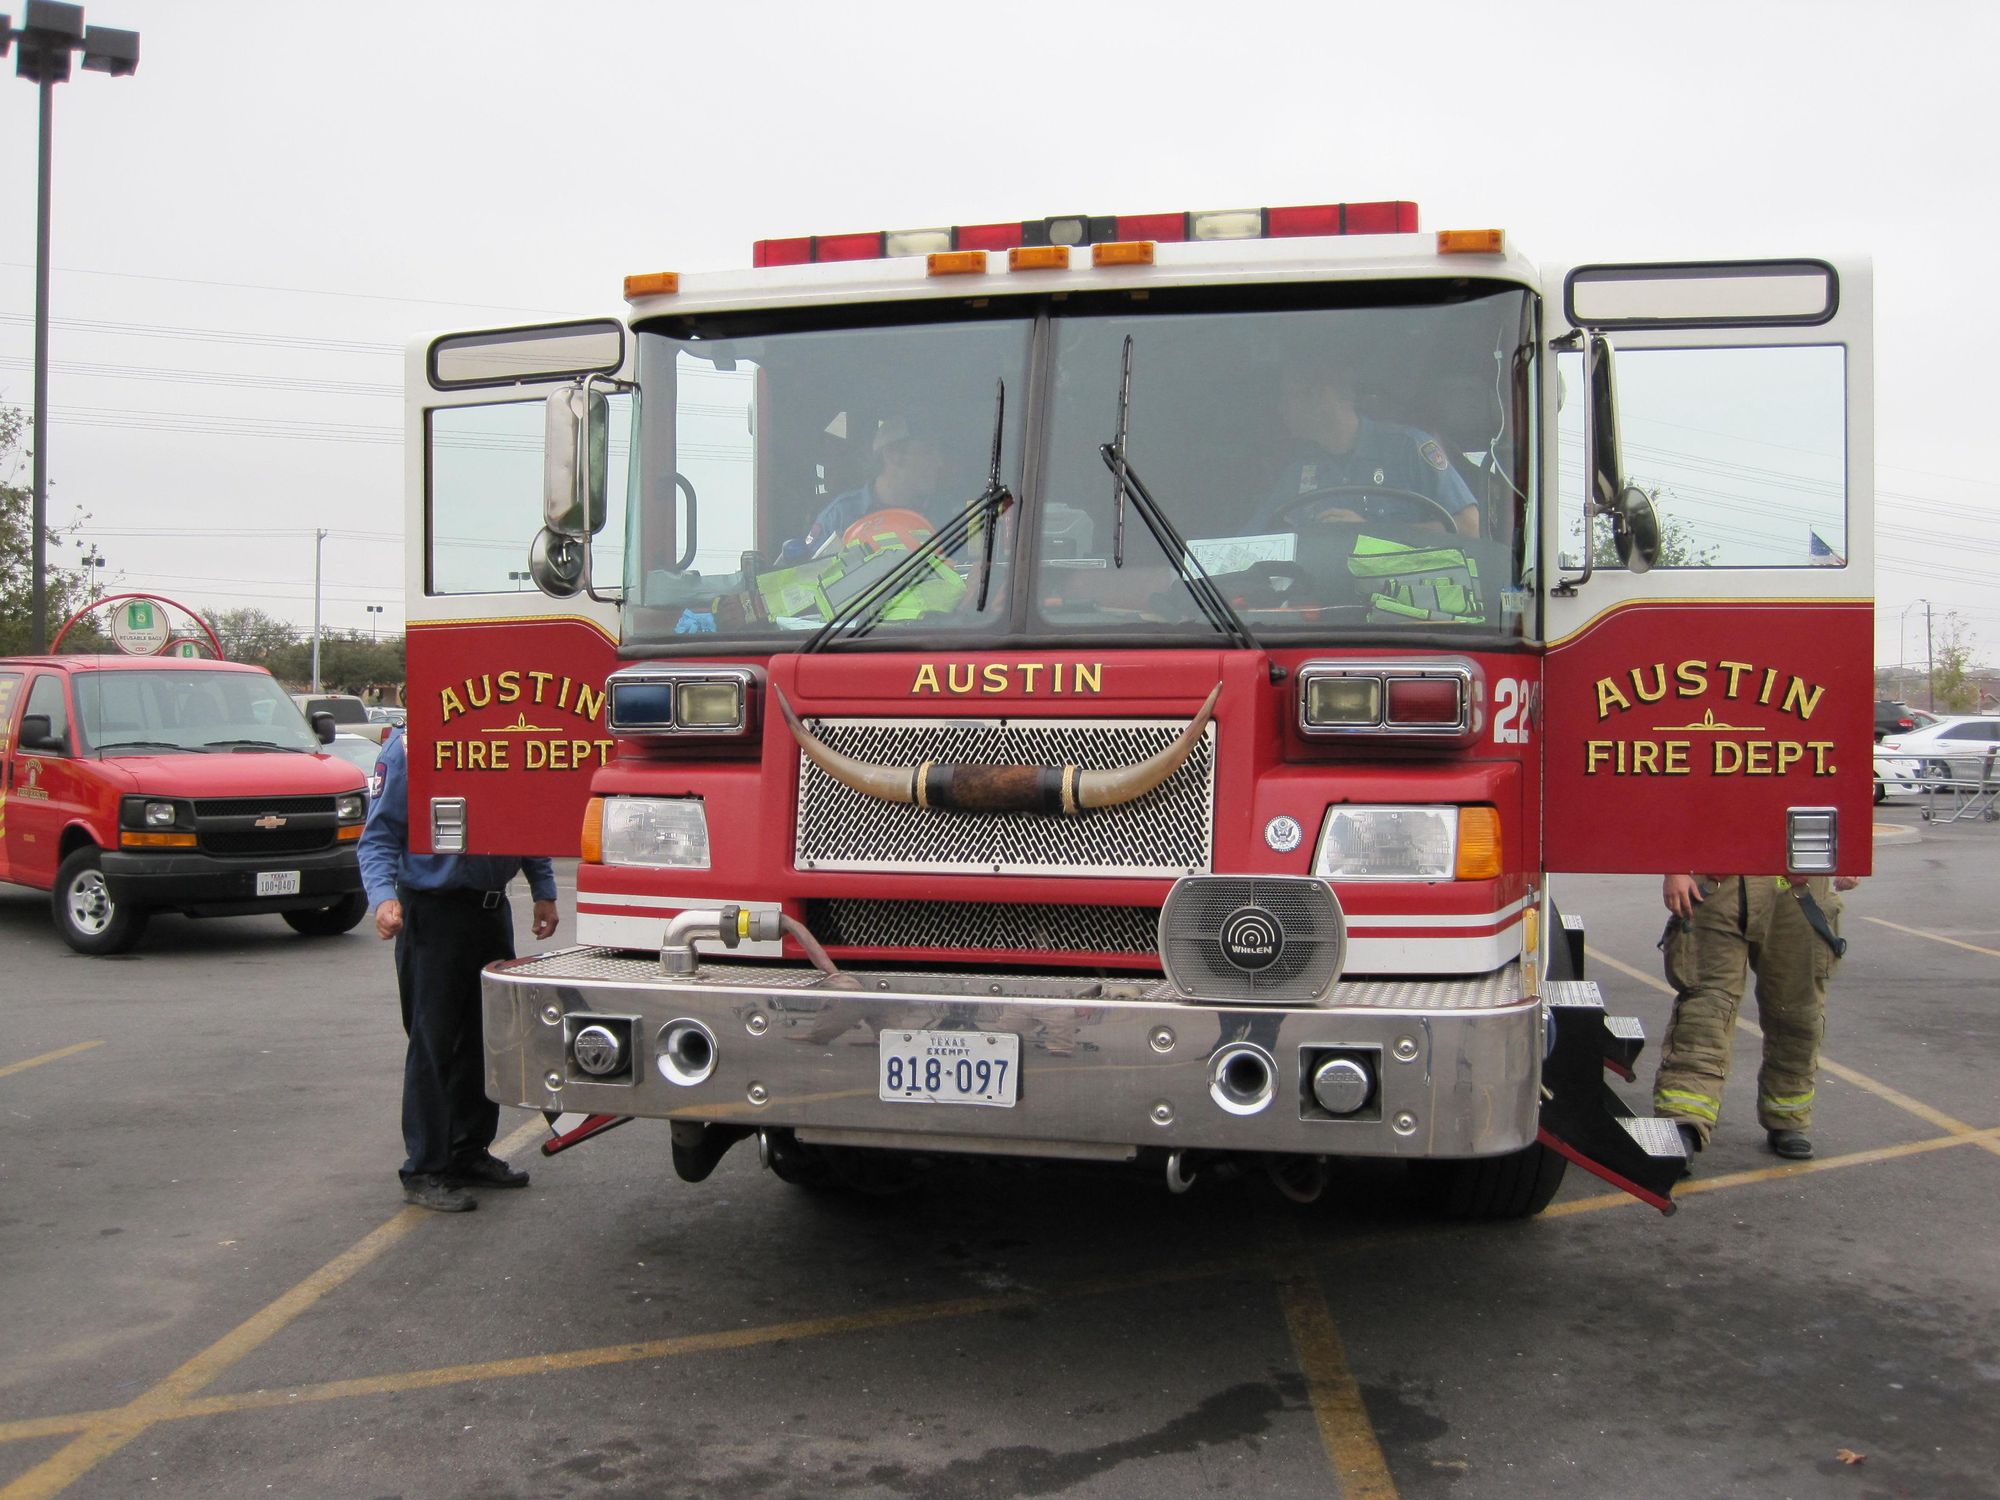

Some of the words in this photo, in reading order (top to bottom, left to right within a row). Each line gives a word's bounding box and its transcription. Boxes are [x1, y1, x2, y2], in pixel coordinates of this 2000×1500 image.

[911, 663, 1102, 693] AUSTIN
[1596, 660, 1826, 720] AUSTIN
[439, 671, 605, 722] AUSTIN
[1493, 677, 1529, 743] 22
[435, 741, 510, 770] FIRE
[526, 740, 614, 769] DEPT
[1585, 740, 1691, 774] FIRE
[1713, 740, 1838, 774] DEPT.
[1231, 945, 1273, 954] WHELEN
[926, 1047, 970, 1056] EXEMPT
[929, 1036, 966, 1046] TEXAS
